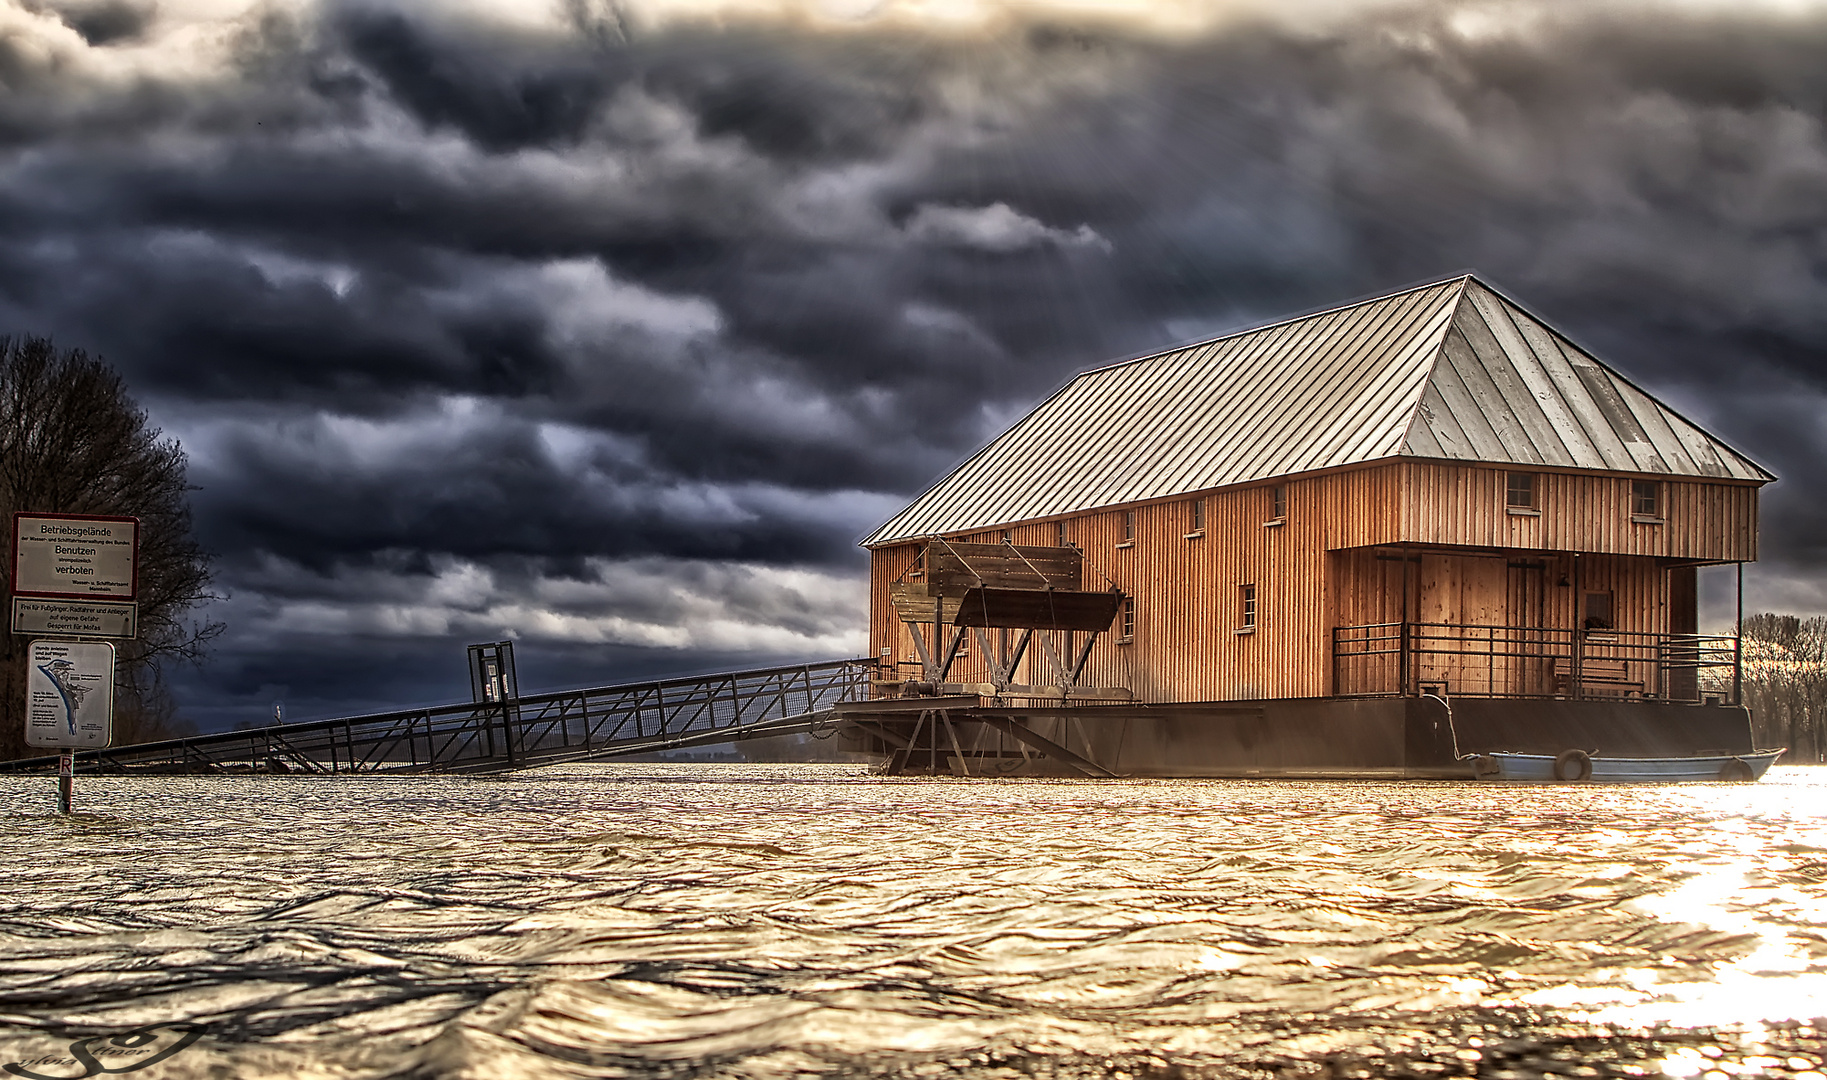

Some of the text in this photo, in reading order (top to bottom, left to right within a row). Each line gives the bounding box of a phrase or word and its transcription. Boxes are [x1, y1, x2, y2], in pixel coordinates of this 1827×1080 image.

[40, 524, 112, 537] Betriebsgelände
[55, 545, 96, 555] Benutzen
[56, 565, 93, 575] verboten
[47, 622, 72, 631] Gesperrt
[61, 758, 72, 773] R
